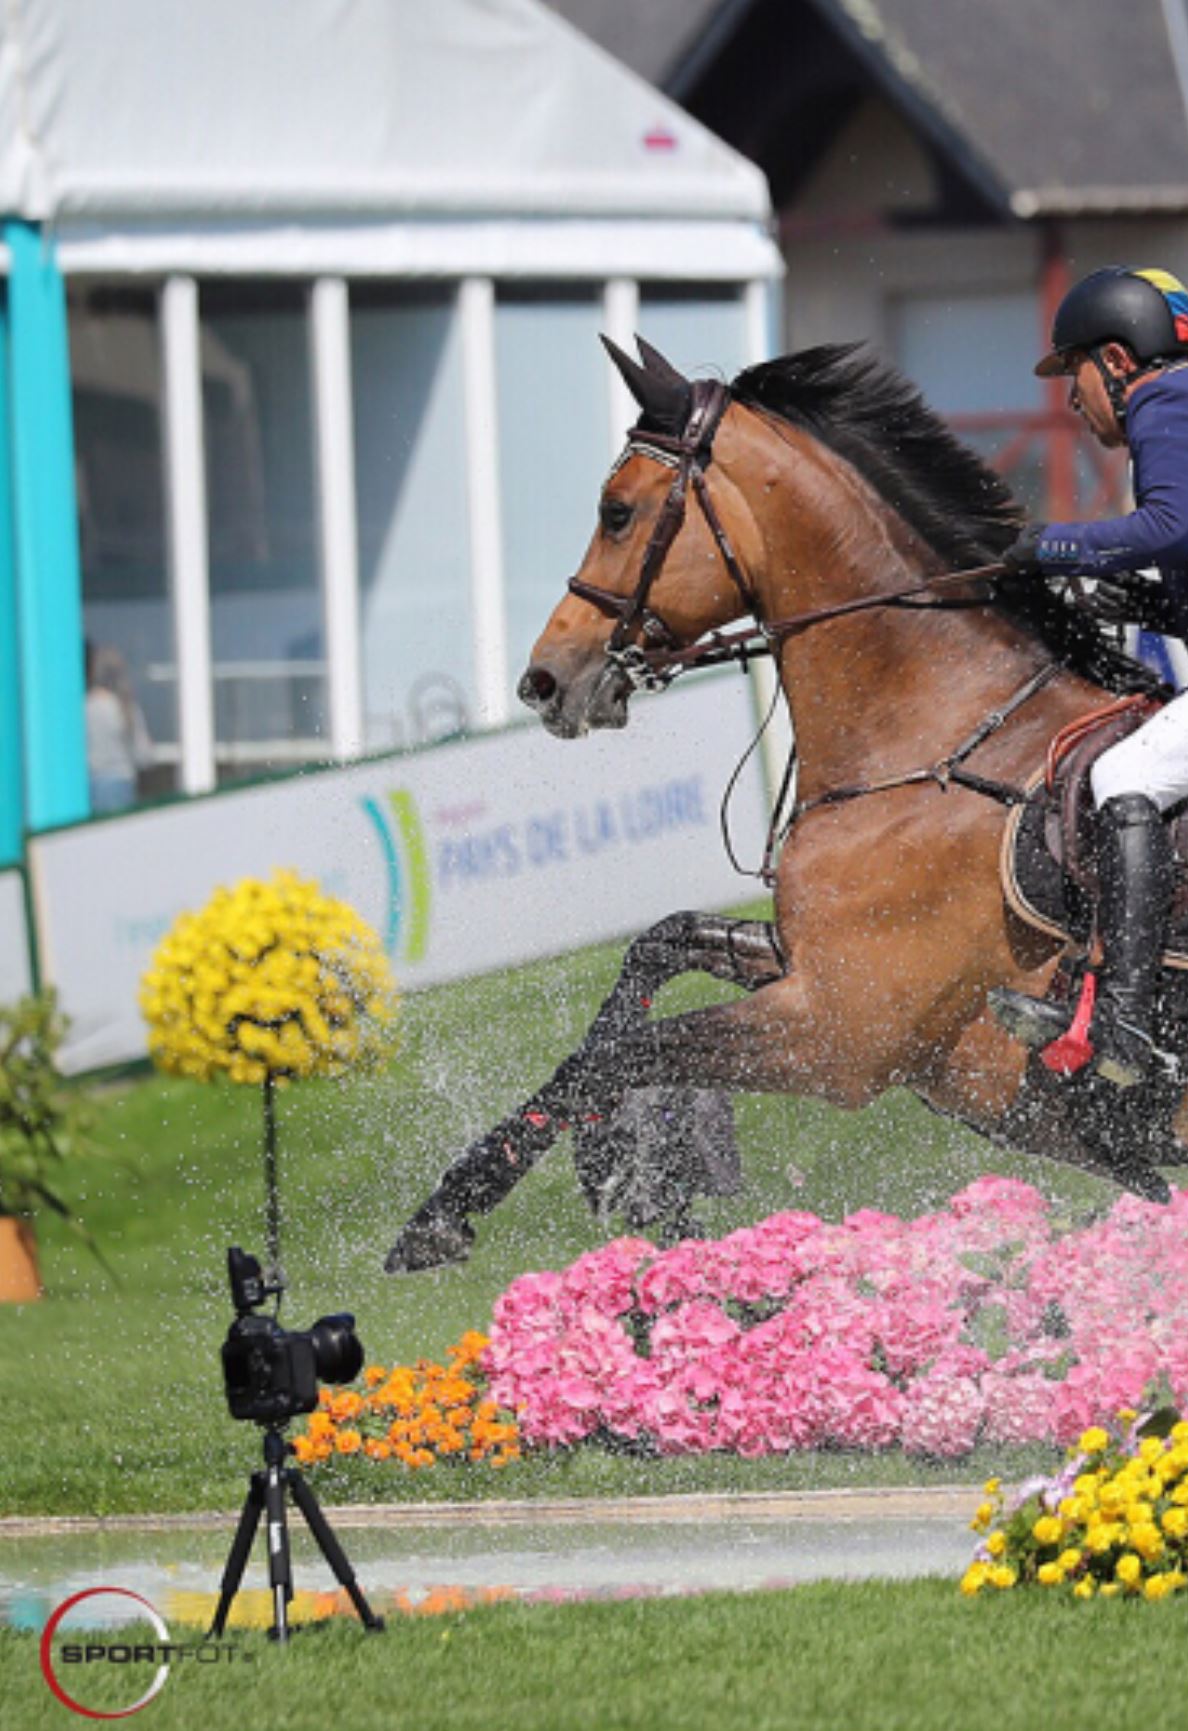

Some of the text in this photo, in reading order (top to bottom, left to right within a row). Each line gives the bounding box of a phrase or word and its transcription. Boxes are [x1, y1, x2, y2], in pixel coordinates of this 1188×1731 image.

[438, 823, 522, 888] PAYS
[527, 809, 569, 868] DE
[573, 799, 618, 855] LA
[620, 774, 707, 844] LOIRE
